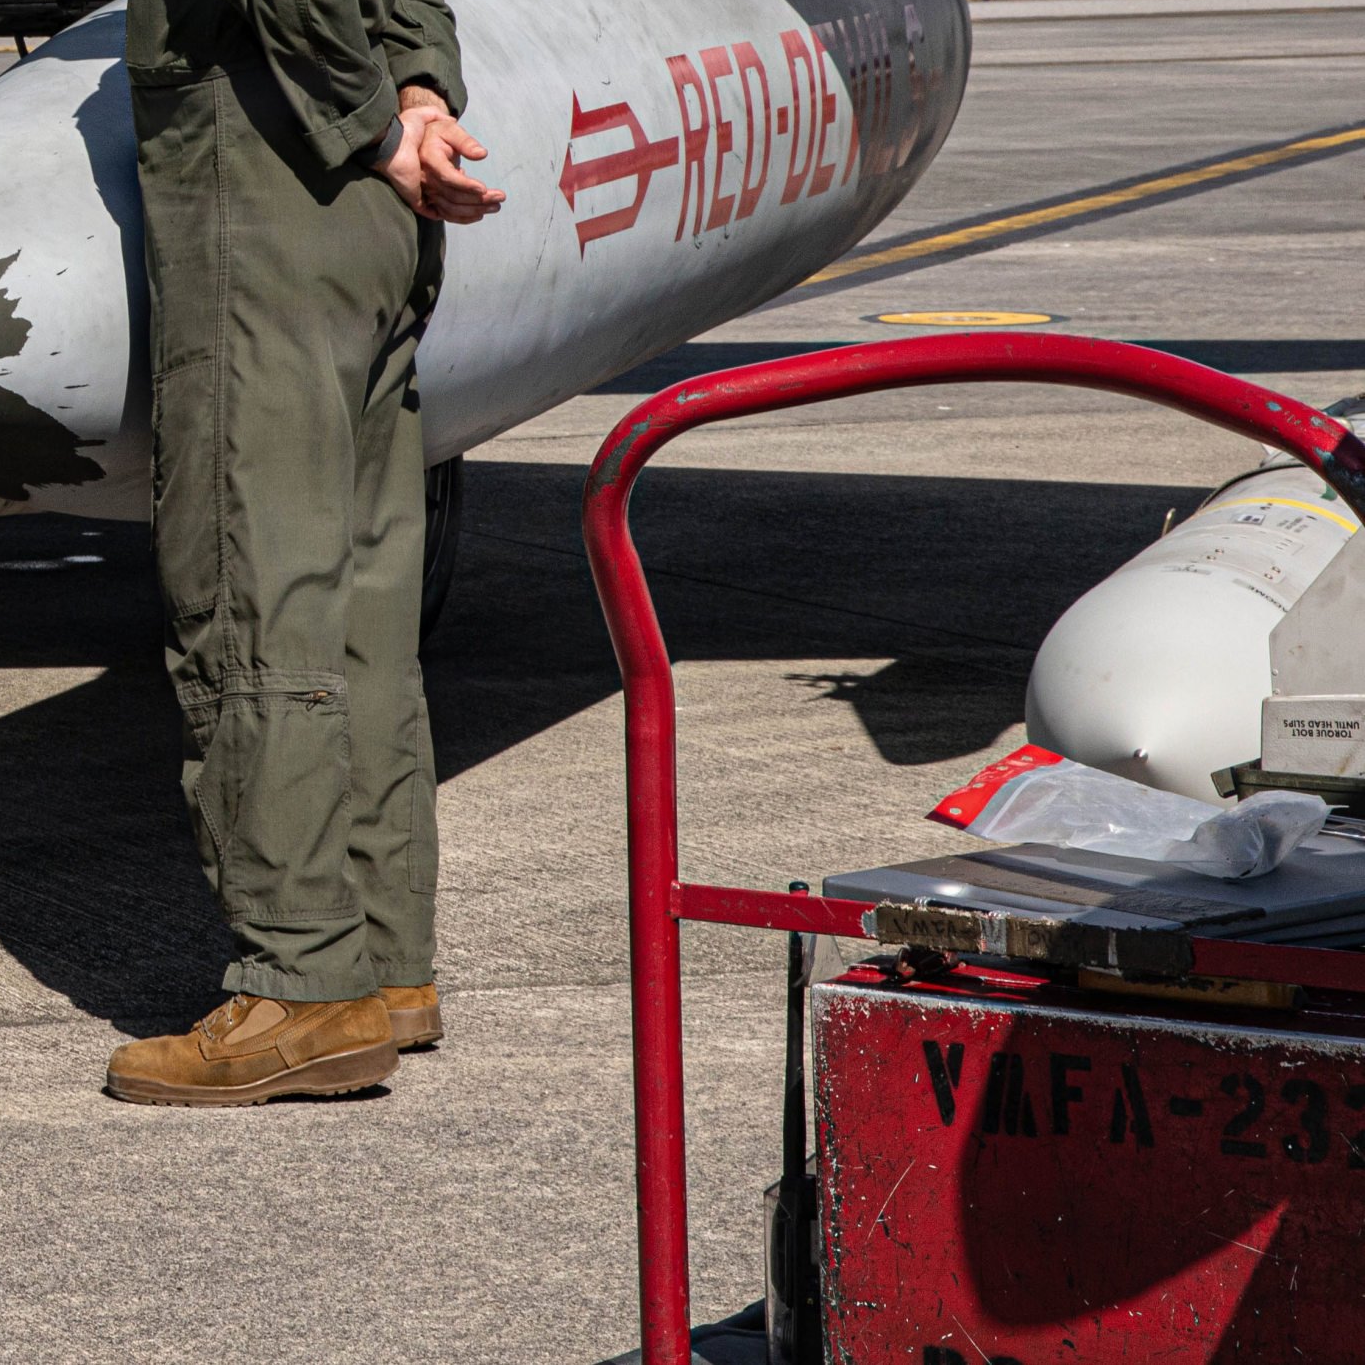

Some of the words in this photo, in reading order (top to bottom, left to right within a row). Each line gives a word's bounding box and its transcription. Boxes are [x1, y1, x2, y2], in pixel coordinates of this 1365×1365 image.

[1283, 719, 1305, 728] SLIPS
[1307, 720, 1332, 728] HEAD
[1334, 721, 1360, 729] UNTIL
[1291, 728, 1314, 737] BOLT
[1316, 729, 1352, 738] TORQUE
